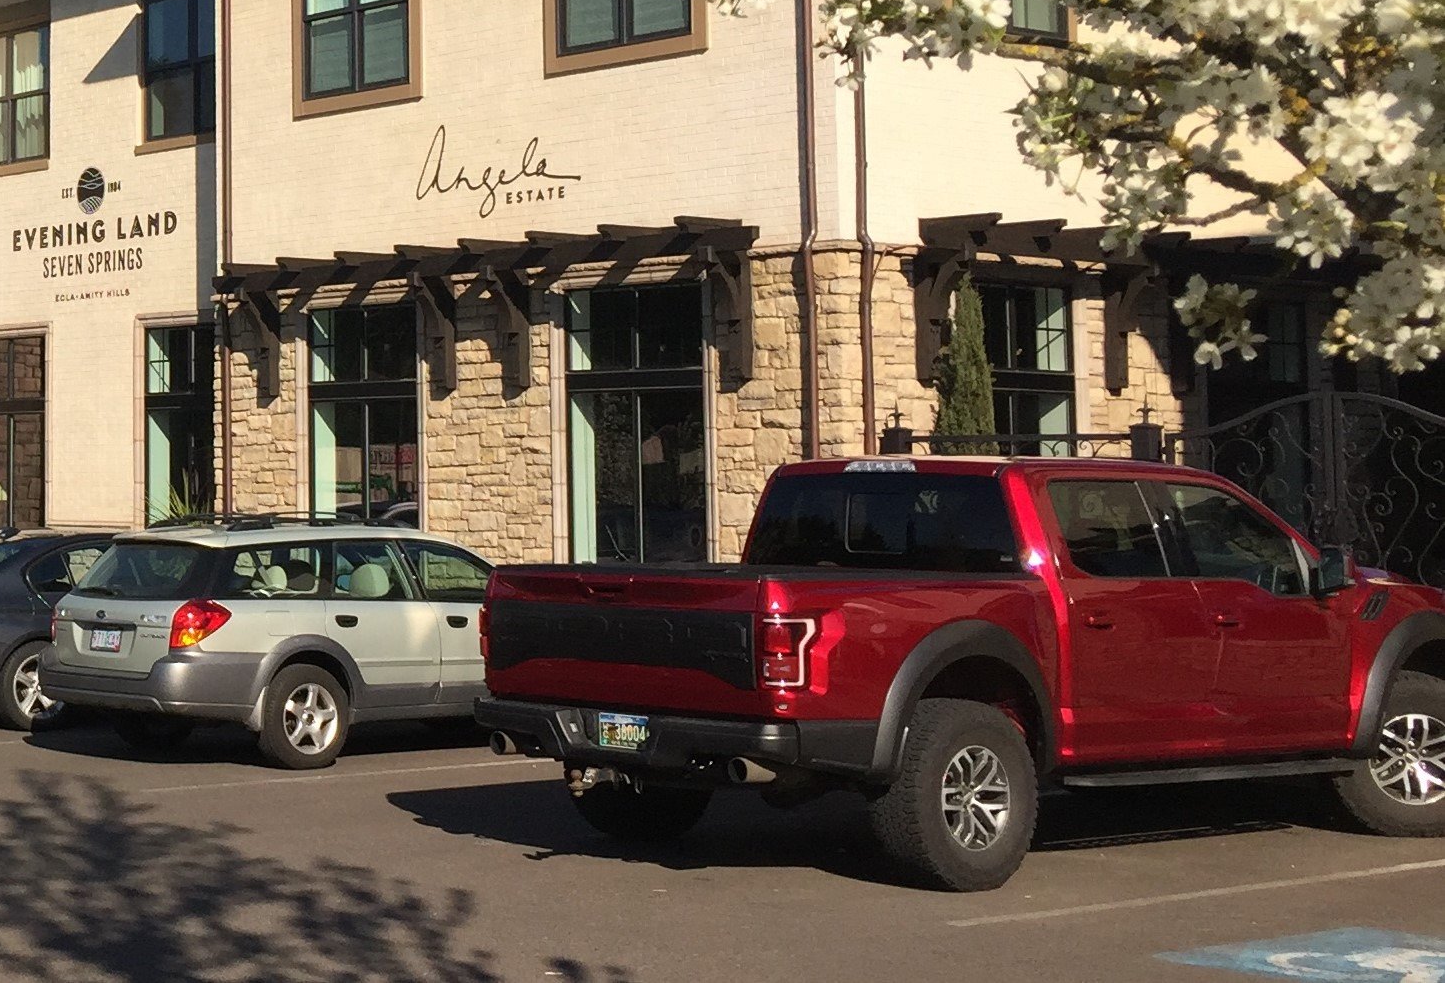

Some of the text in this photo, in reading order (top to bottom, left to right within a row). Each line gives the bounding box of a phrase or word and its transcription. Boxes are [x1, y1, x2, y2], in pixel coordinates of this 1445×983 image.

[416, 124, 582, 219] Angela
[505, 185, 566, 205] ESTATE
[12, 210, 178, 252] EVENING LAND
[43, 247, 144, 279] SEVEN SPRINGS
